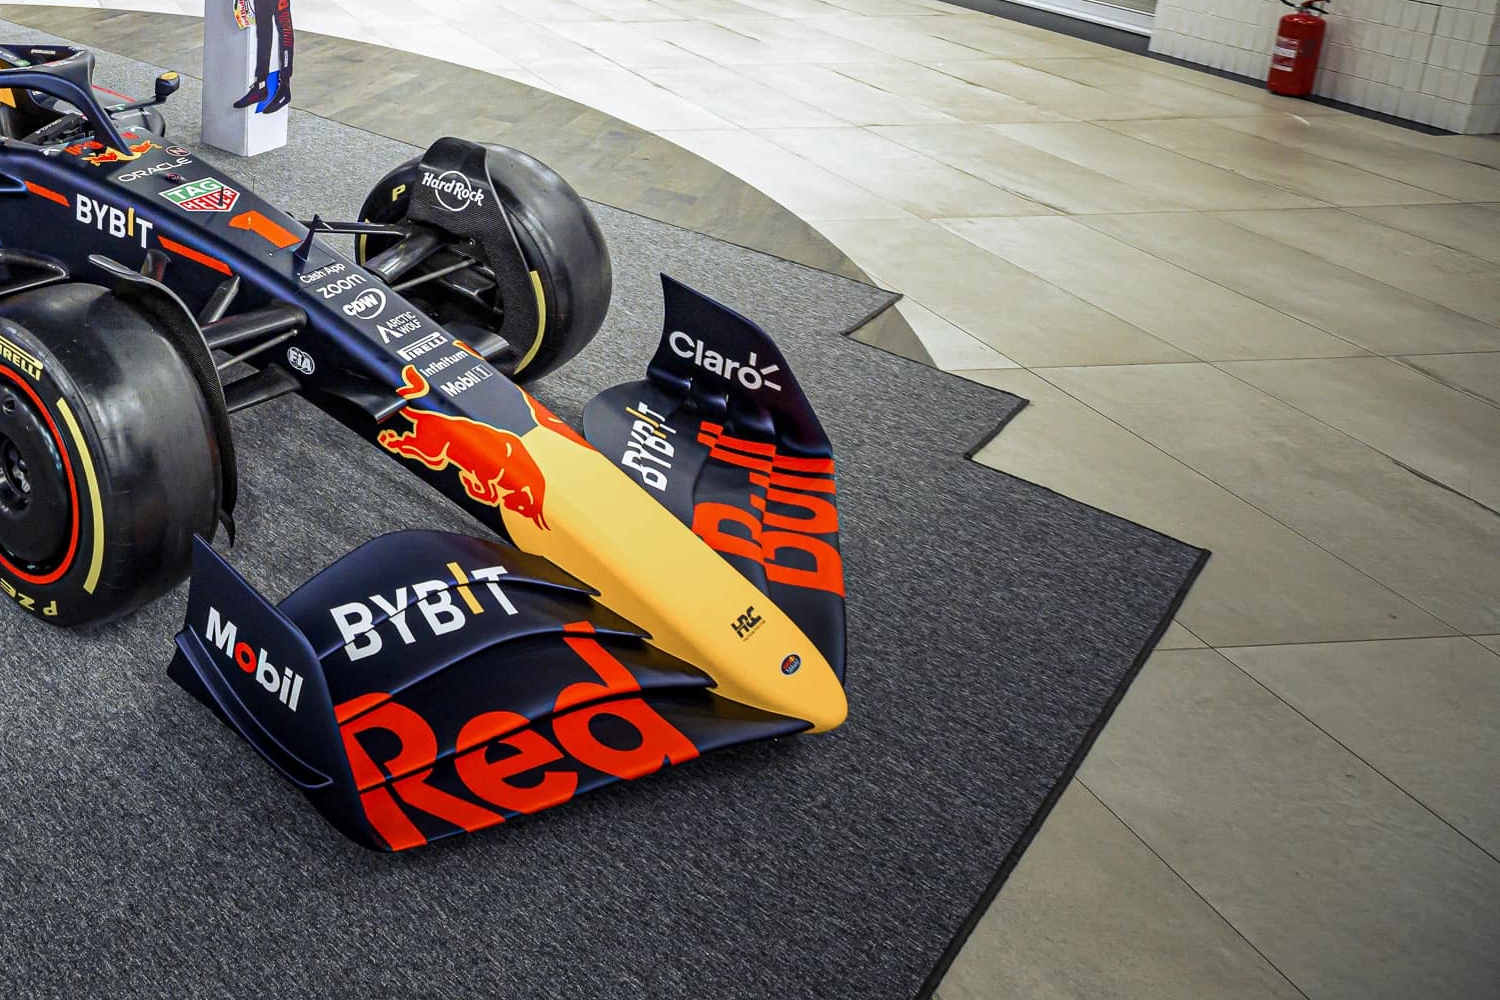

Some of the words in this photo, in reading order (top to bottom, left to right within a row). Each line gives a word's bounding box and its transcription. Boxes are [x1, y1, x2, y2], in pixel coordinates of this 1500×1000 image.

[117, 157, 193, 182] ORACLE
[167, 180, 219, 200] TAG
[75, 193, 153, 249] BYBIT
[300, 269, 328, 284] Cash
[324, 262, 346, 277] App
[316, 273, 367, 299] zoom
[342, 293, 379, 317] CDW
[386, 311, 417, 329] ARCTIC
[398, 320, 422, 336] WOLF
[396, 332, 449, 362] PIRELLI
[668, 330, 765, 392] Claro
[440, 370, 481, 398] Mobil
[621, 401, 677, 492] BYBIT
[691, 420, 846, 599] Bull
[329, 561, 519, 663] BYBIT
[205, 606, 304, 712] Mobil
[333, 621, 701, 852] Red
